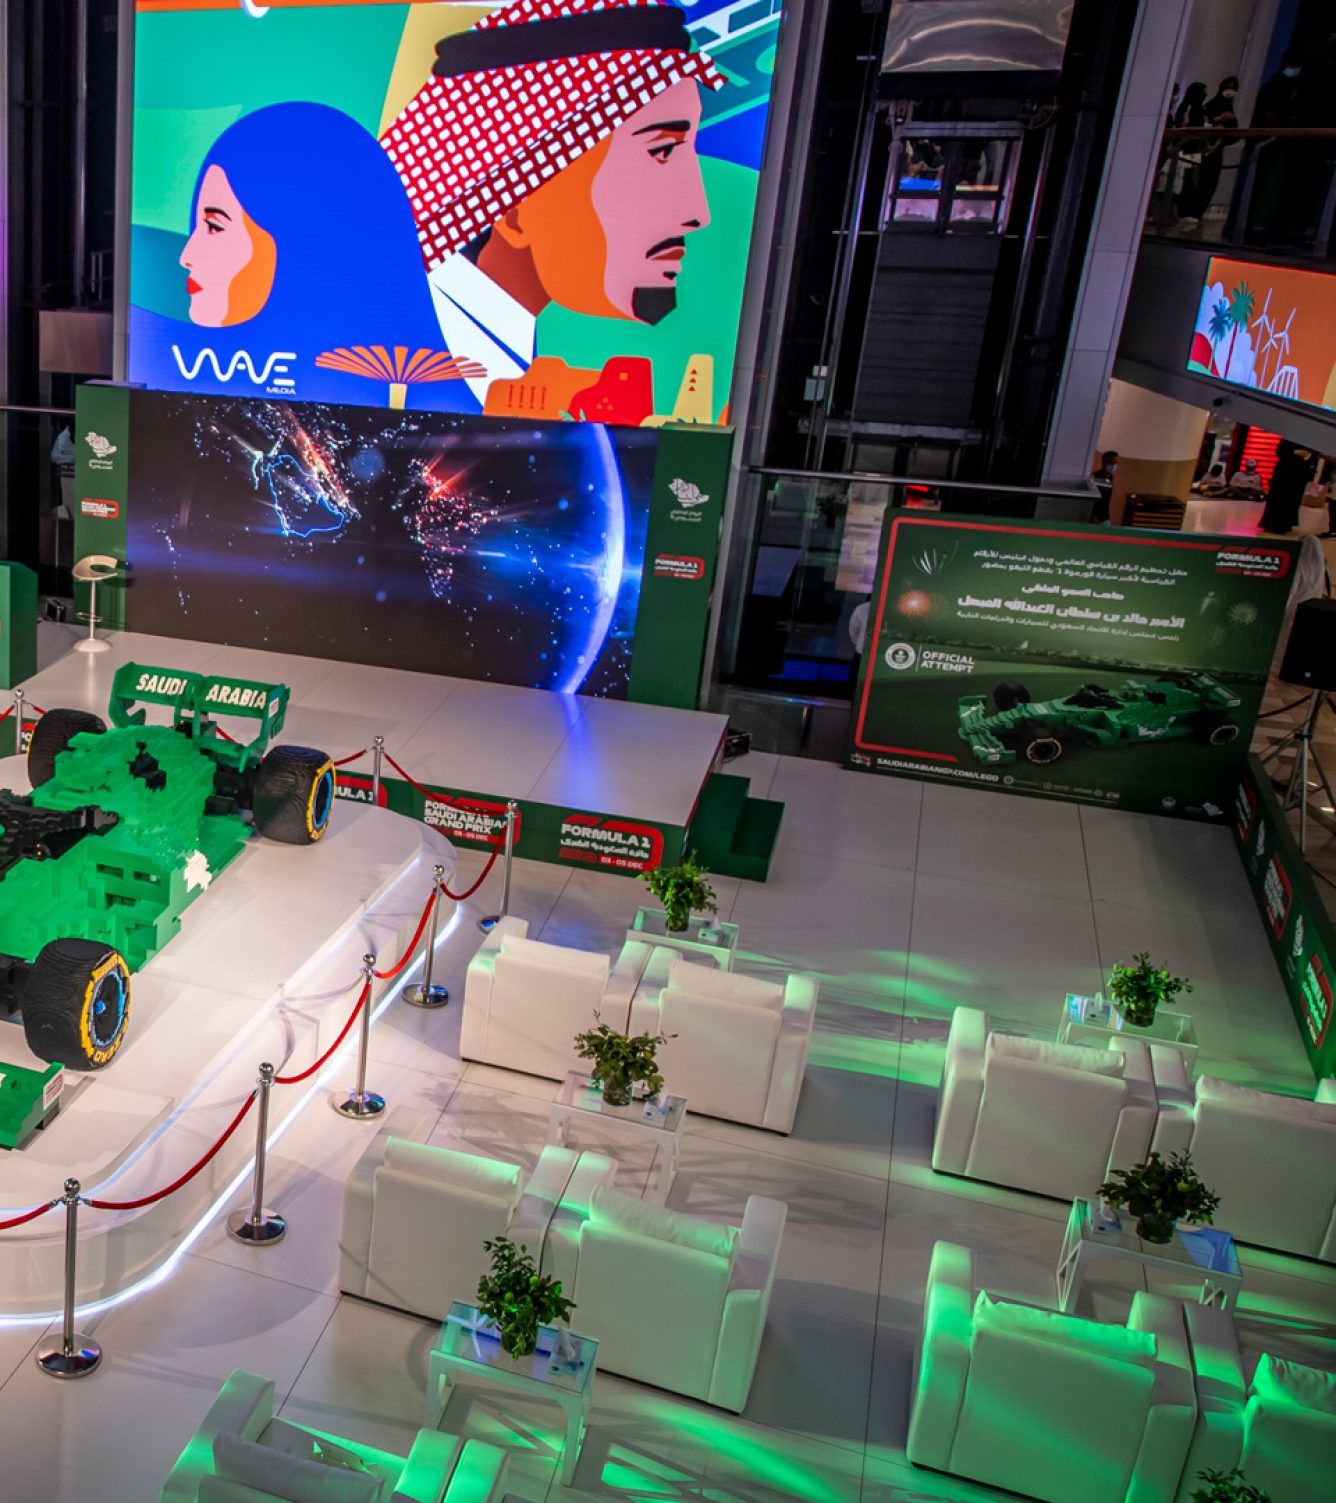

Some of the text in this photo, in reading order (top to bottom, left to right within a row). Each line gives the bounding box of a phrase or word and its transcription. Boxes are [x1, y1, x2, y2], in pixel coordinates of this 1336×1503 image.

[172, 345, 297, 386] WAVE
[266, 387, 297, 395] MEDIA
[655, 558, 692, 568] FORMULA
[1217, 552, 1272, 563] FORMULA
[922, 650, 975, 665] OFFICIAL
[920, 660, 974, 674] ATTEMPT
[135, 673, 268, 709] SAUDI ARABIA
[876, 758, 1000, 782] SAUDIARABIANGP.COM/LEGO
[424, 808, 457, 819] SAUDI
[424, 816, 492, 834] GRAND PRIX
[561, 823, 651, 848] FORMULA 1
[601, 856, 611, 864] 03
[627, 861, 643, 869] DEC
